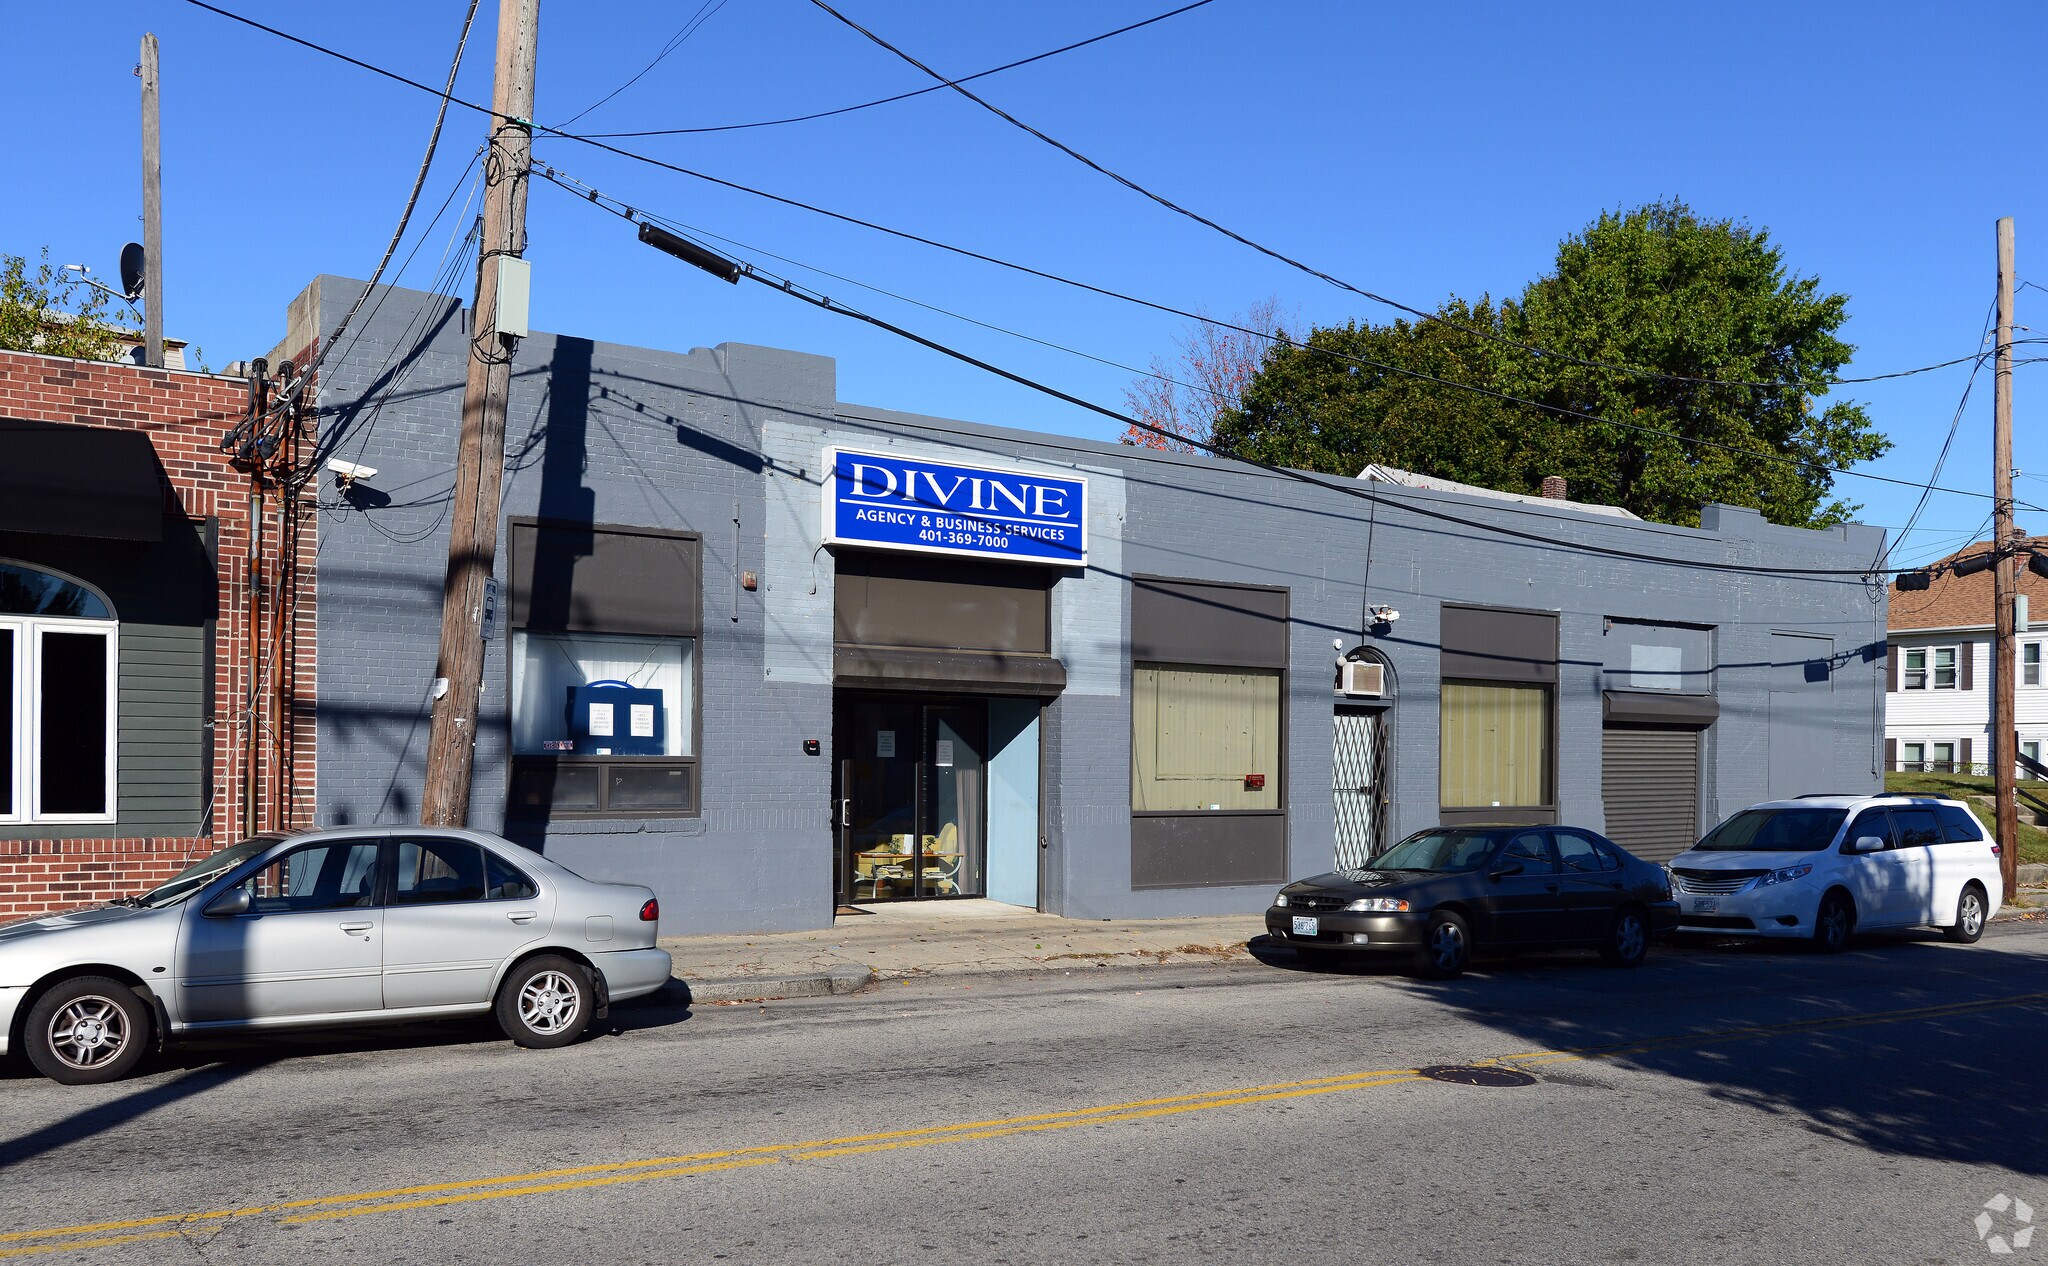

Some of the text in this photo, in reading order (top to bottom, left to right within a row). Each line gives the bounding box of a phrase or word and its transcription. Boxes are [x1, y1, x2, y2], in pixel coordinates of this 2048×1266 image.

[849, 462, 1071, 519] DIVINE
[855, 508, 1065, 541] AGENCY & BUSINESS SERVICES
[918, 529, 1009, 549] 401-369-7000
